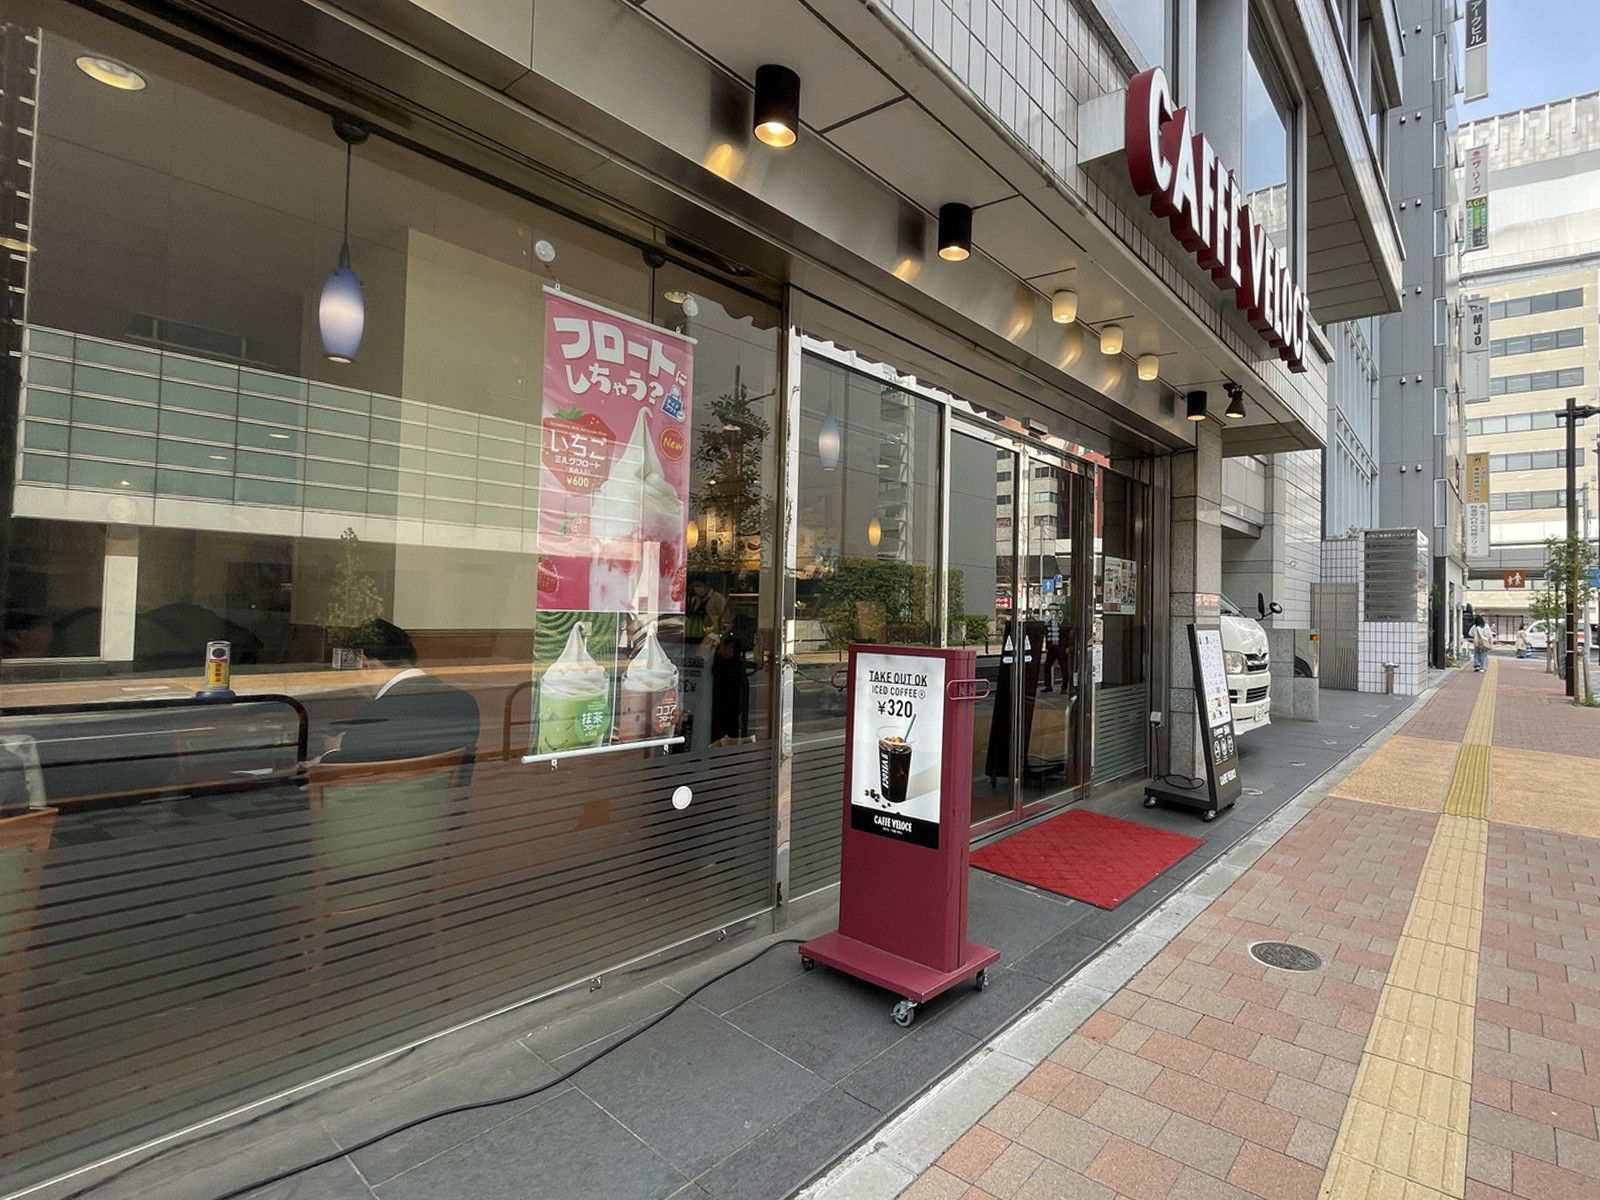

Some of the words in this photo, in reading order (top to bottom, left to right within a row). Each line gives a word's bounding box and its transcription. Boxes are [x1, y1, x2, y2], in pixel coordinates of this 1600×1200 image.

[1467, 198, 1487, 208] AGA
[1246, 203, 1310, 372] VELOCE
[553, 317, 688, 387] フロートに
[565, 363, 664, 405] しちゃう?
[663, 436, 684, 450] New
[555, 455, 602, 469] ミルクフロート
[566, 476, 589, 487] ¥600
[869, 670, 892, 683] TAKE
[894, 672, 912, 685] OUT
[914, 674, 928, 687] OK
[871, 684, 889, 695] ICED
[656, 704, 677, 716] ココア
[877, 698, 913, 719] ¥320
[581, 711, 604, 725] 抹茶
[891, 818, 913, 833] VELOCE
